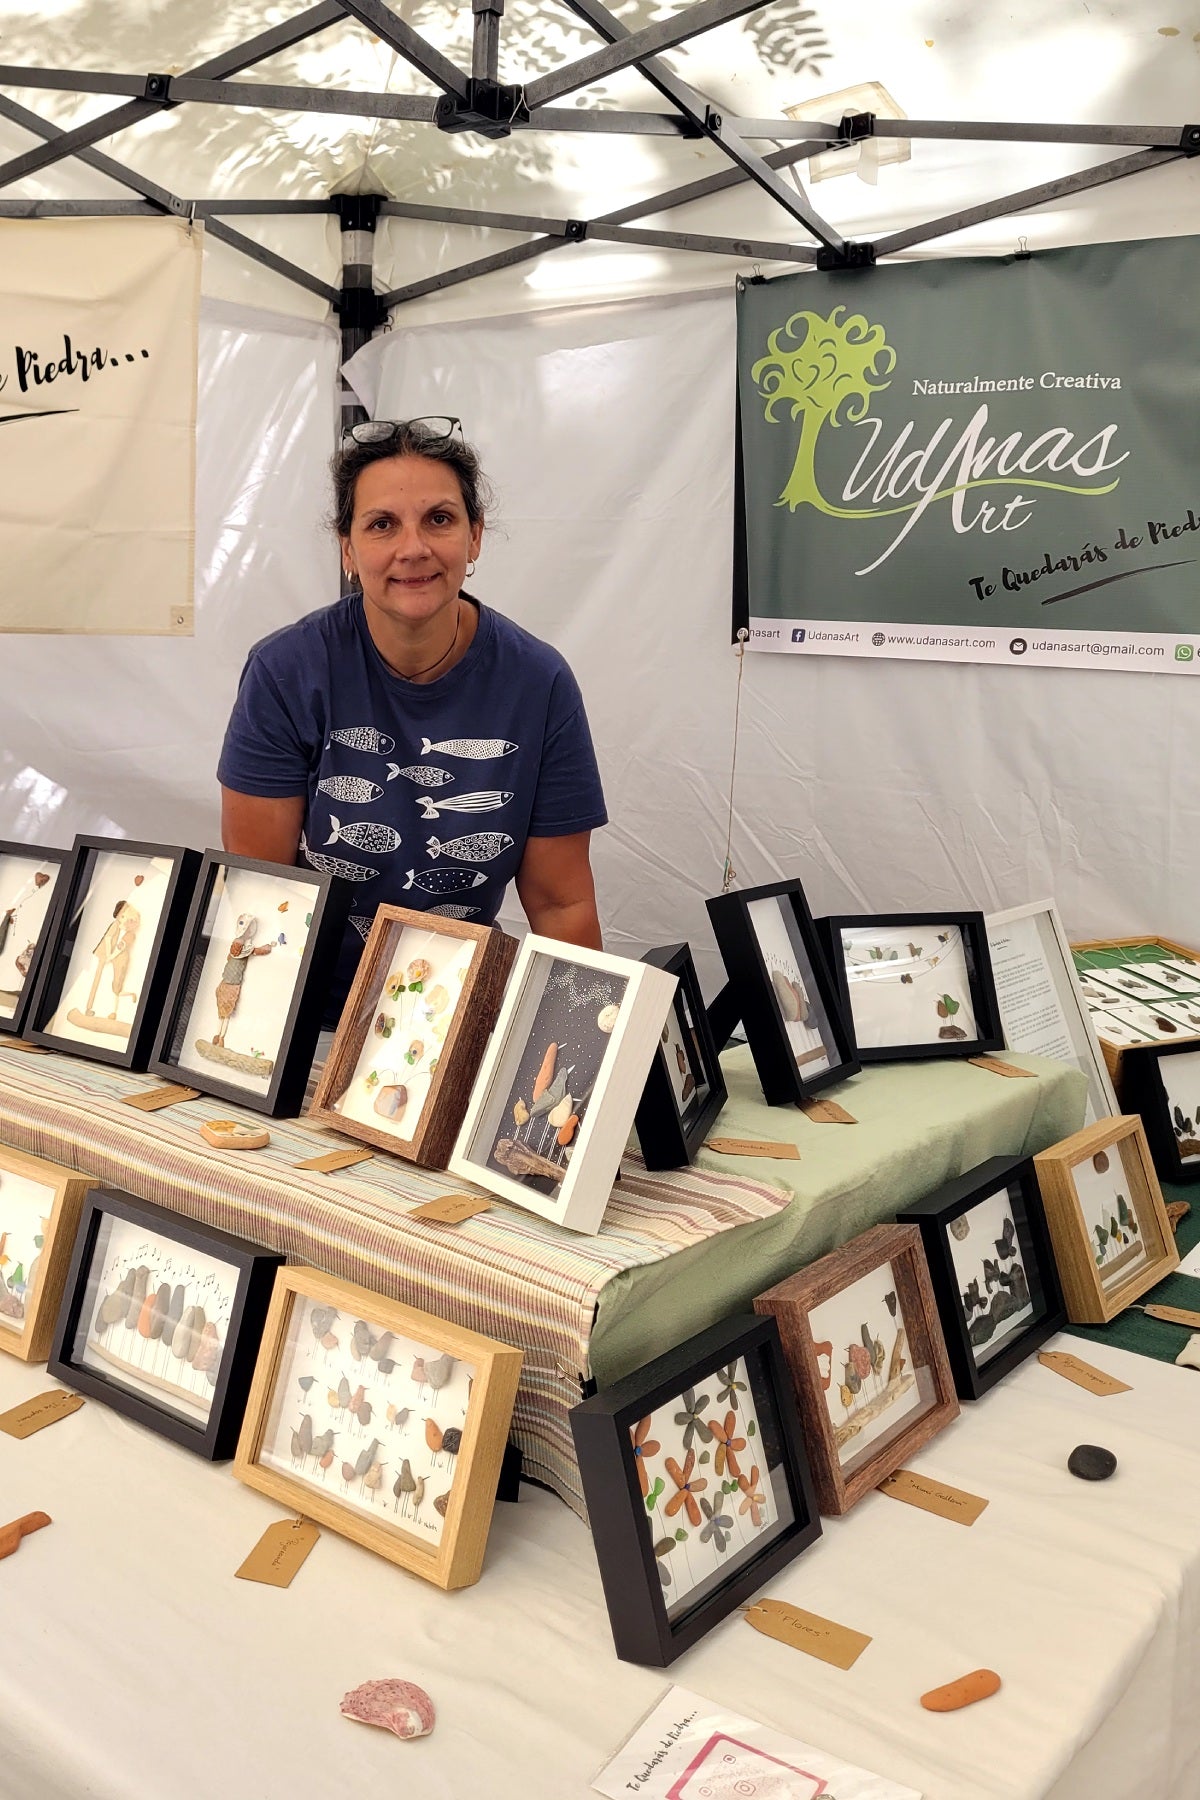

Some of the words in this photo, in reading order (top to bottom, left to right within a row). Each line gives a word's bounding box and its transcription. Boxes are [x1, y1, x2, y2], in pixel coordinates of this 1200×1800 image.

[15, 334, 149, 392] Piedra...
[912, 375, 1034, 396] Naturalmente
[1039, 371, 1122, 390] Creativa
[969, 576, 997, 600] Te
[1002, 543, 1108, 591] Quedarás
[1114, 528, 1143, 550] de
[750, 629, 780, 639] nasart
[807, 631, 860, 642] UdanasArt
[887, 634, 996, 649] www.udanasart.com
[1032, 641, 1165, 656] udanasart@gmail.com
[626, 1782, 640, 1792] Te
[634, 1751, 668, 1782] Quedarás
[660, 1740, 673, 1748] de
